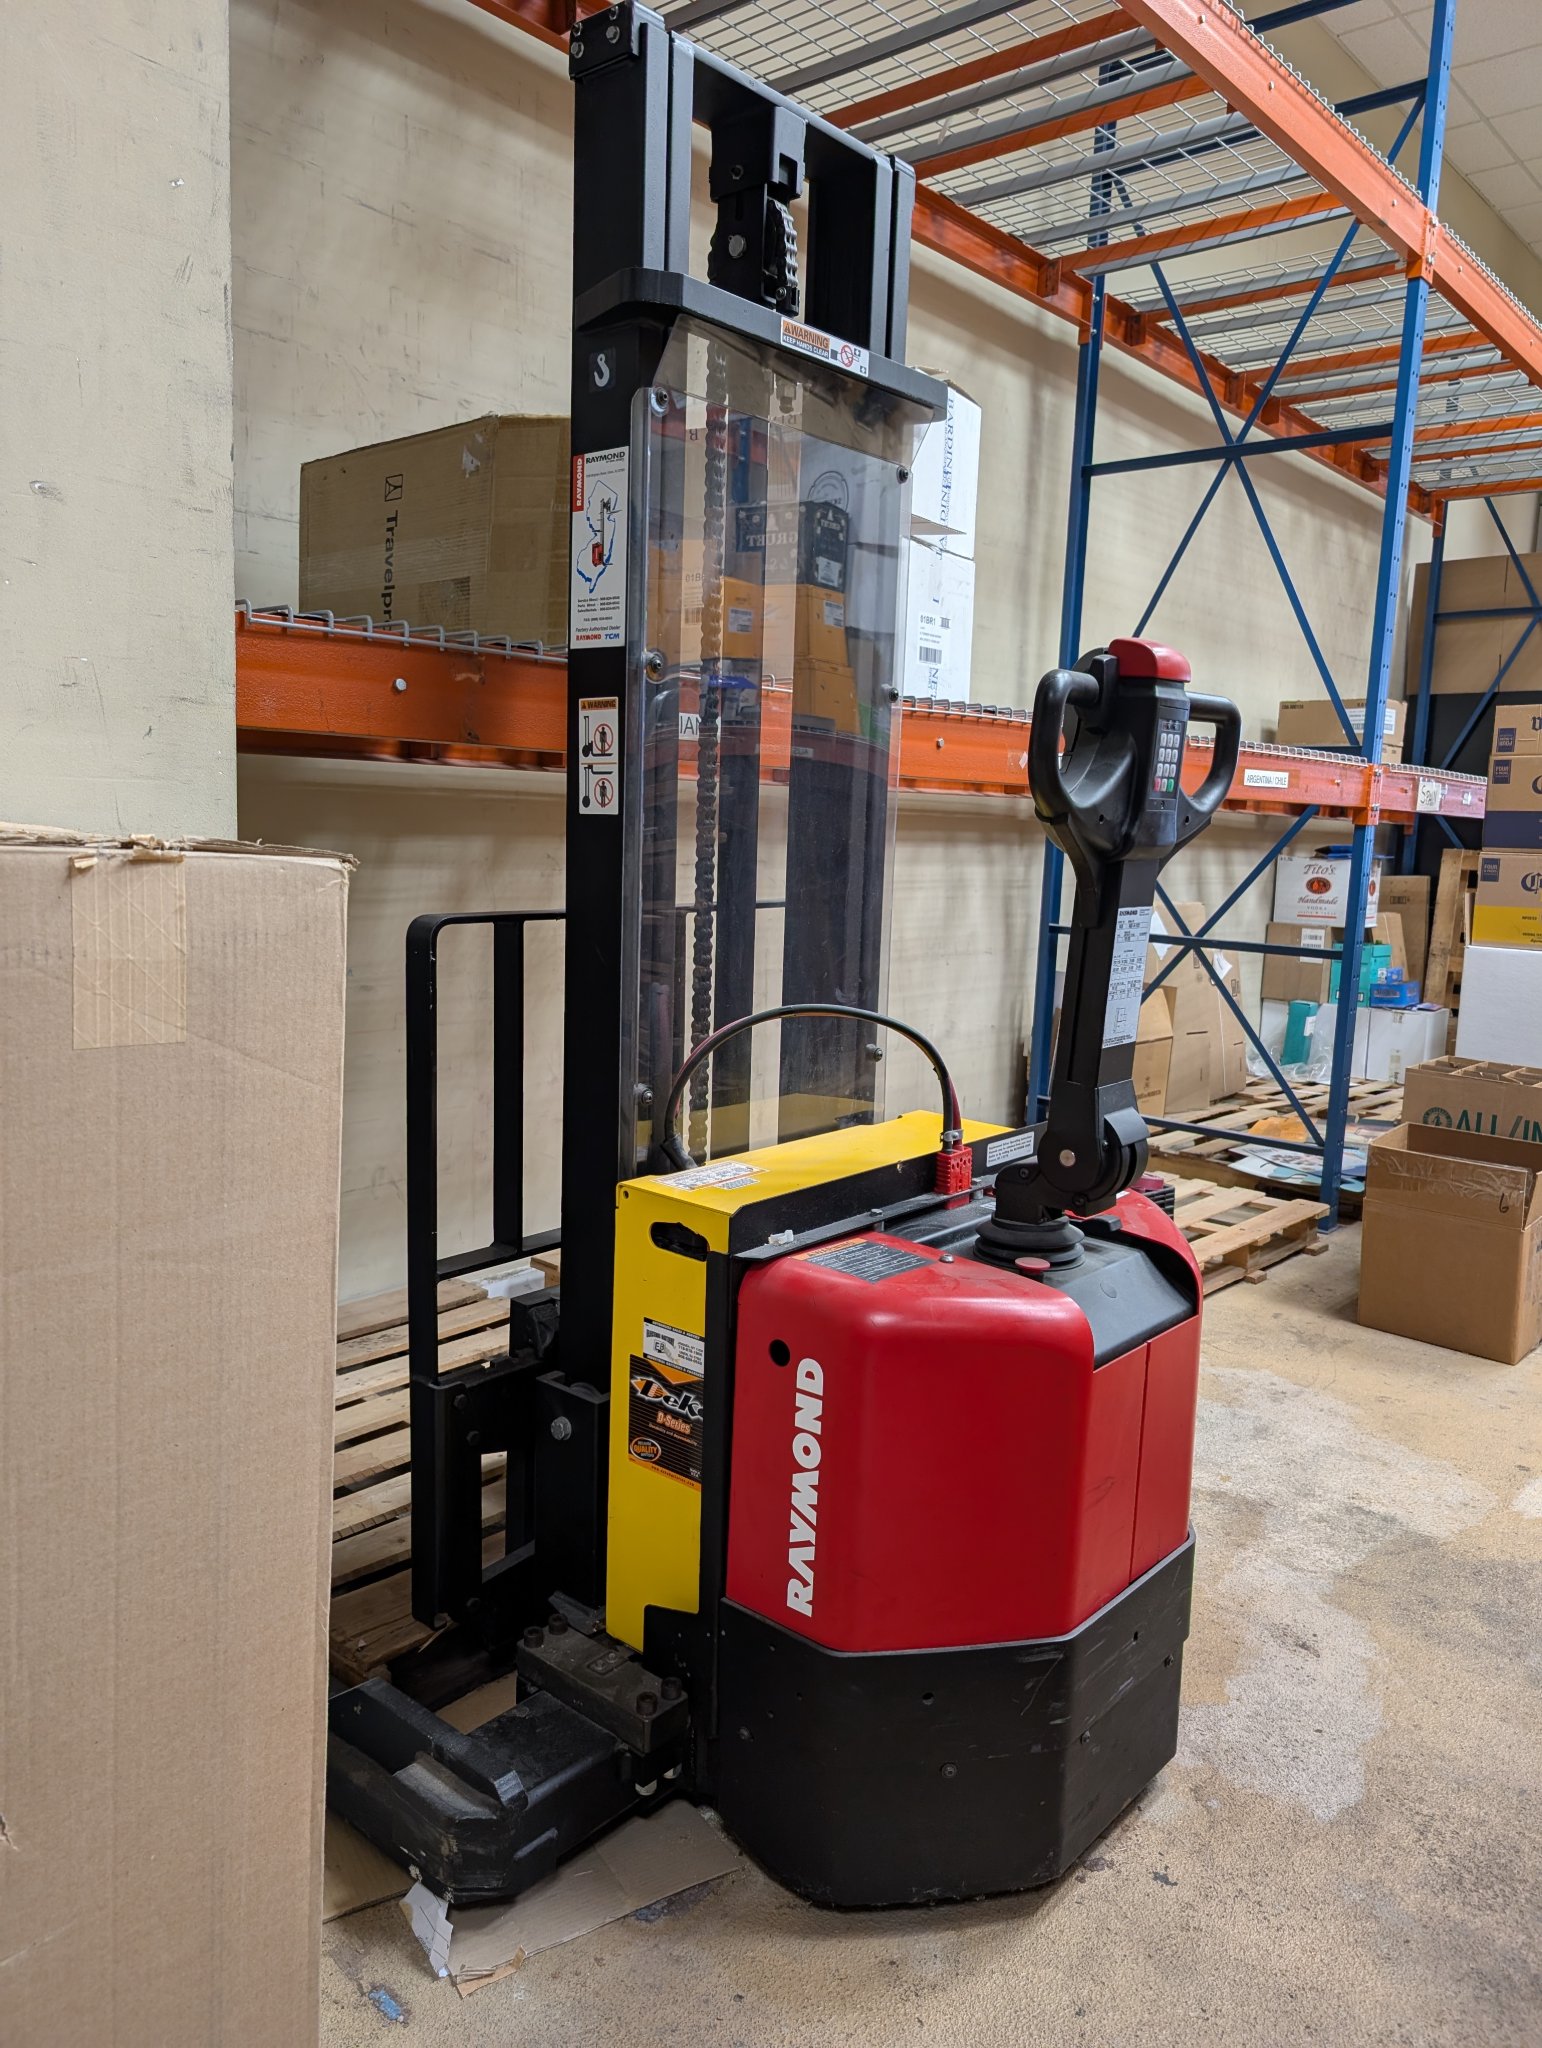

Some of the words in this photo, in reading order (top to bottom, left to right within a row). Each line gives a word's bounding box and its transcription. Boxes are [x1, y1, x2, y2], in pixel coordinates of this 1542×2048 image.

[790, 324, 830, 349] WARNING
[783, 335, 796, 345] KEEP
[796, 340, 813, 352] HANDS
[813, 346, 829, 358] CLEAR
[586, 451, 626, 464] RAYMOND
[587, 699, 616, 710] WARNING
[1246, 774, 1272, 785] ARGENTINA
[1275, 776, 1287, 786] CHILE
[1303, 863, 1336, 875] Tito's
[1297, 895, 1338, 905] Handmade
[786, 1357, 824, 1618] RAYMOND
